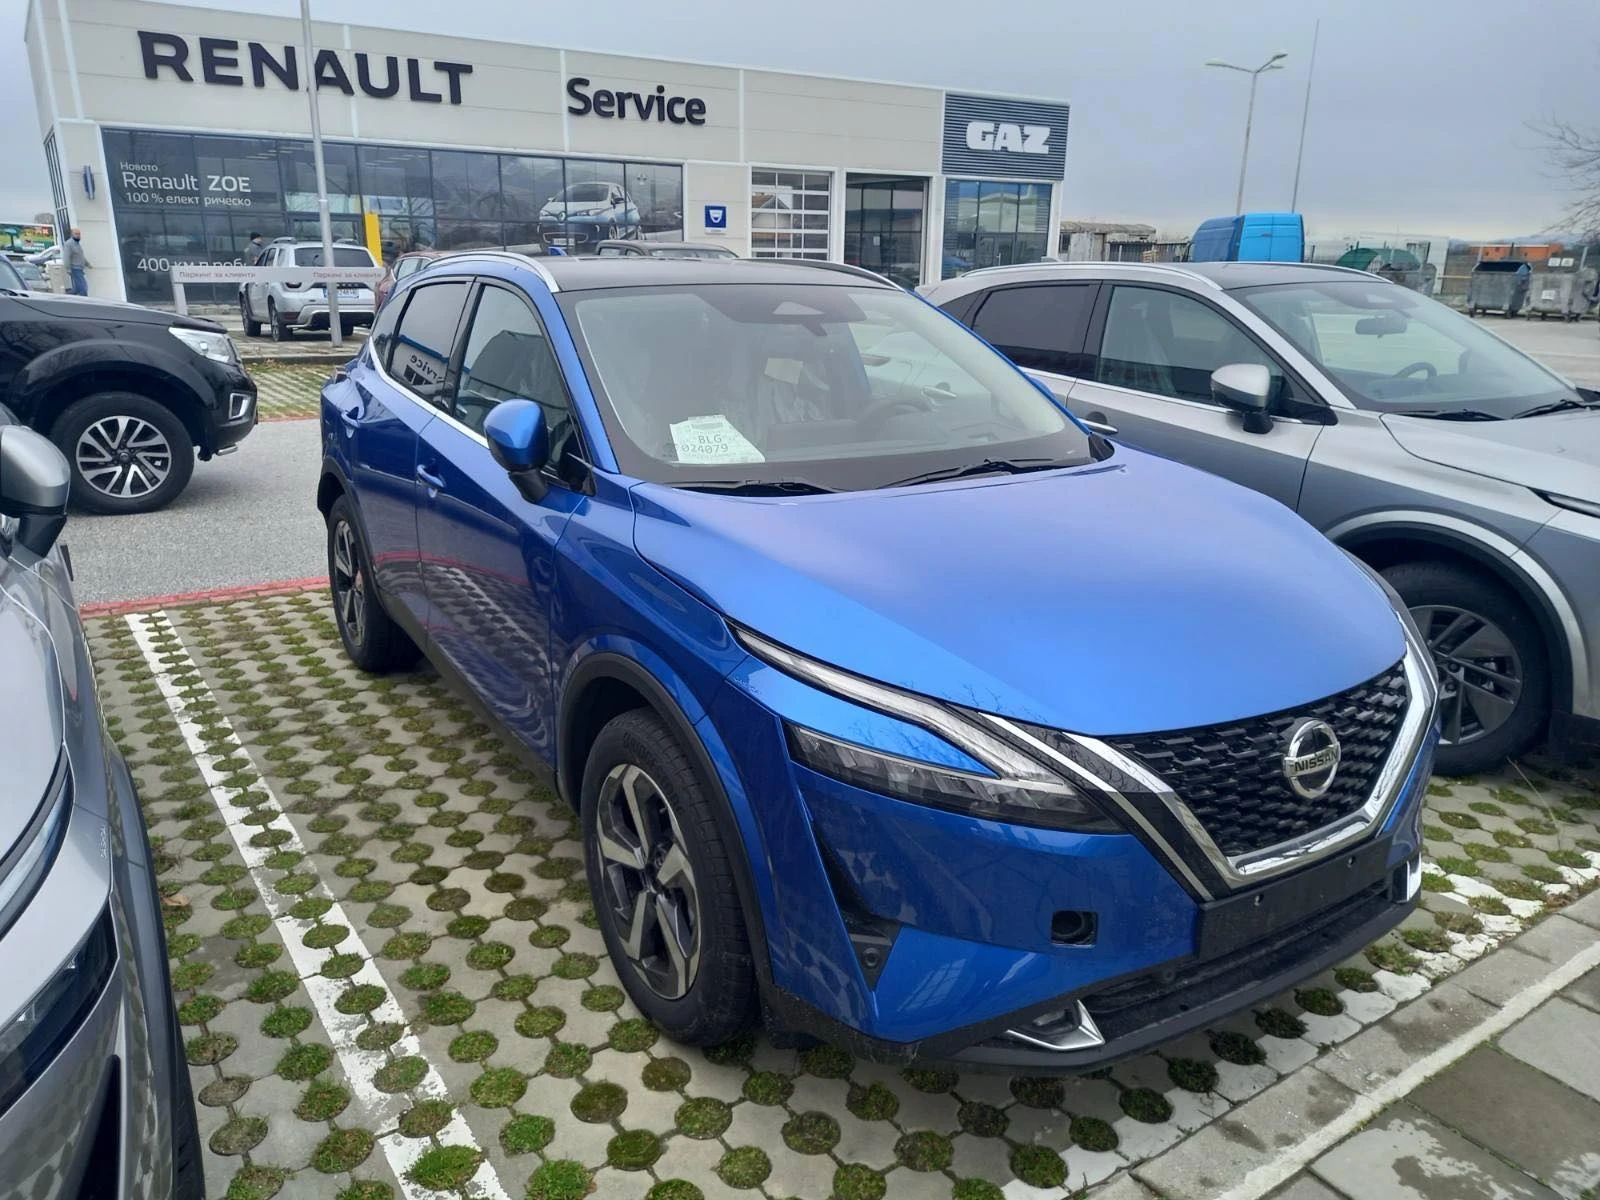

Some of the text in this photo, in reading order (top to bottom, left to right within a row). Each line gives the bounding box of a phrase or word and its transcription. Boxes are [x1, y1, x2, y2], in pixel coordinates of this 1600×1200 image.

[138, 31, 473, 105] RENAULT
[567, 77, 706, 125] Service
[965, 120, 1051, 155] GAZ
[120, 162, 159, 172] Новото
[122, 171, 251, 192] Renault ZOE
[126, 192, 149, 203] 100
[137, 258, 171, 272] 400
[698, 434, 722, 444] BLG
[1294, 749, 1338, 772] NISSAN
